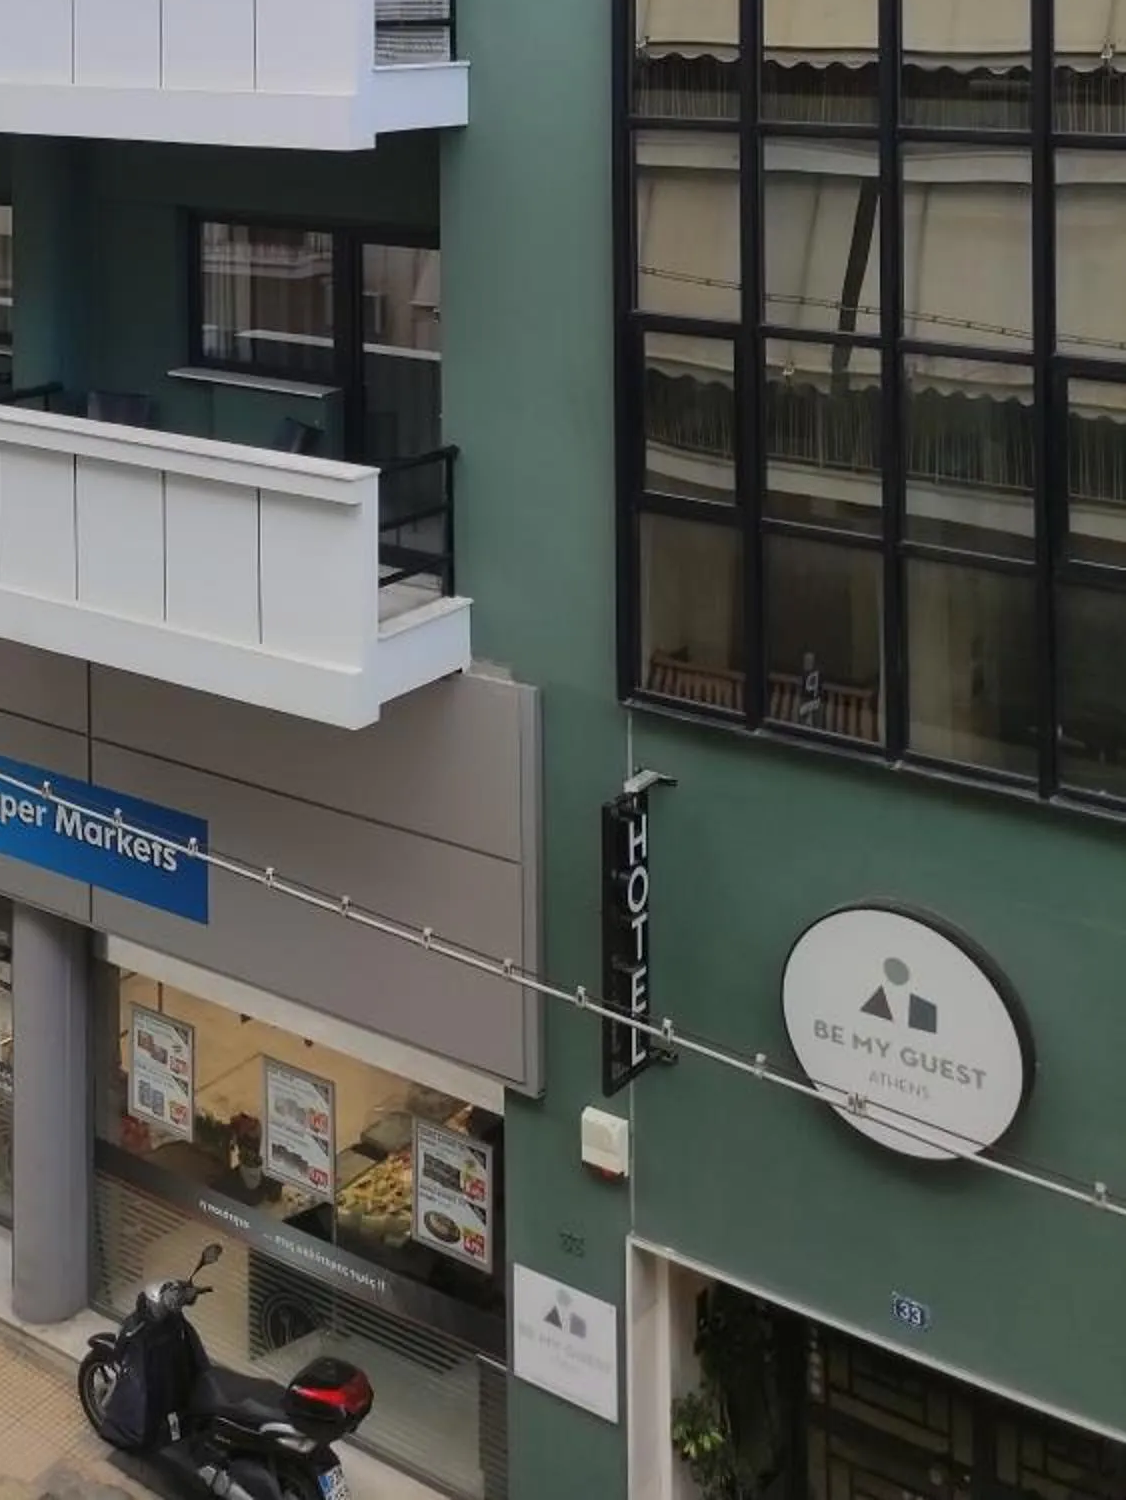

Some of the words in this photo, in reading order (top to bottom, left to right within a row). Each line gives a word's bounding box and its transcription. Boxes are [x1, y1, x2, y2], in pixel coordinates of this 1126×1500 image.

[54, 804, 178, 872] Markets
[627, 813, 649, 1067] HOTEL
[813, 1019, 845, 1045] BE
[851, 1033, 891, 1058] MY
[899, 1047, 987, 1090] GUEST
[868, 1070, 930, 1100] ATHENS
[898, 1302, 921, 1325] 33
